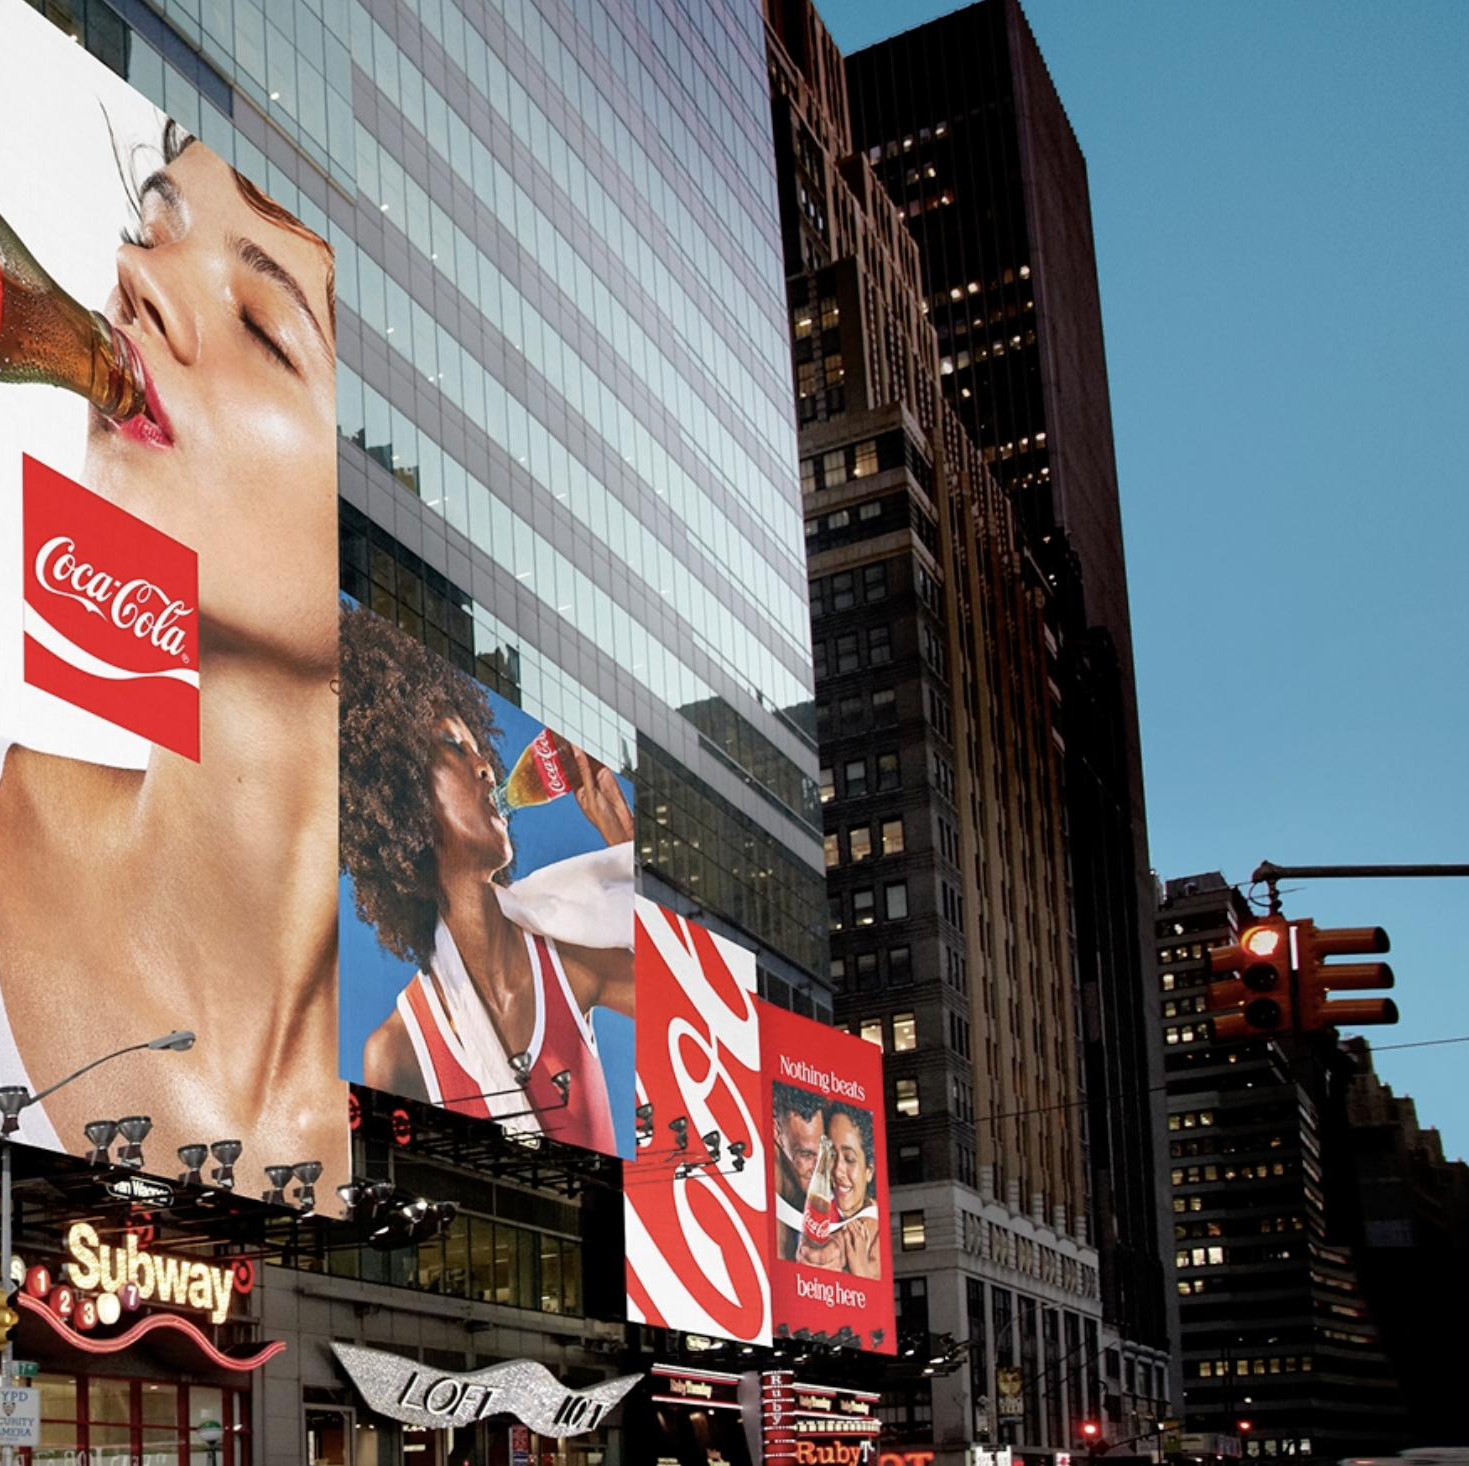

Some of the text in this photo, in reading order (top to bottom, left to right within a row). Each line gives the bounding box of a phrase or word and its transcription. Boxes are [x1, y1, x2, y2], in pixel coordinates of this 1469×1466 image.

[35, 536, 194, 656] Coca-Cola
[779, 1054, 865, 1101] Nothing beats
[68, 1223, 234, 1324] Subway
[796, 1273, 866, 1309] being here
[398, 1372, 503, 1420] LOFT
